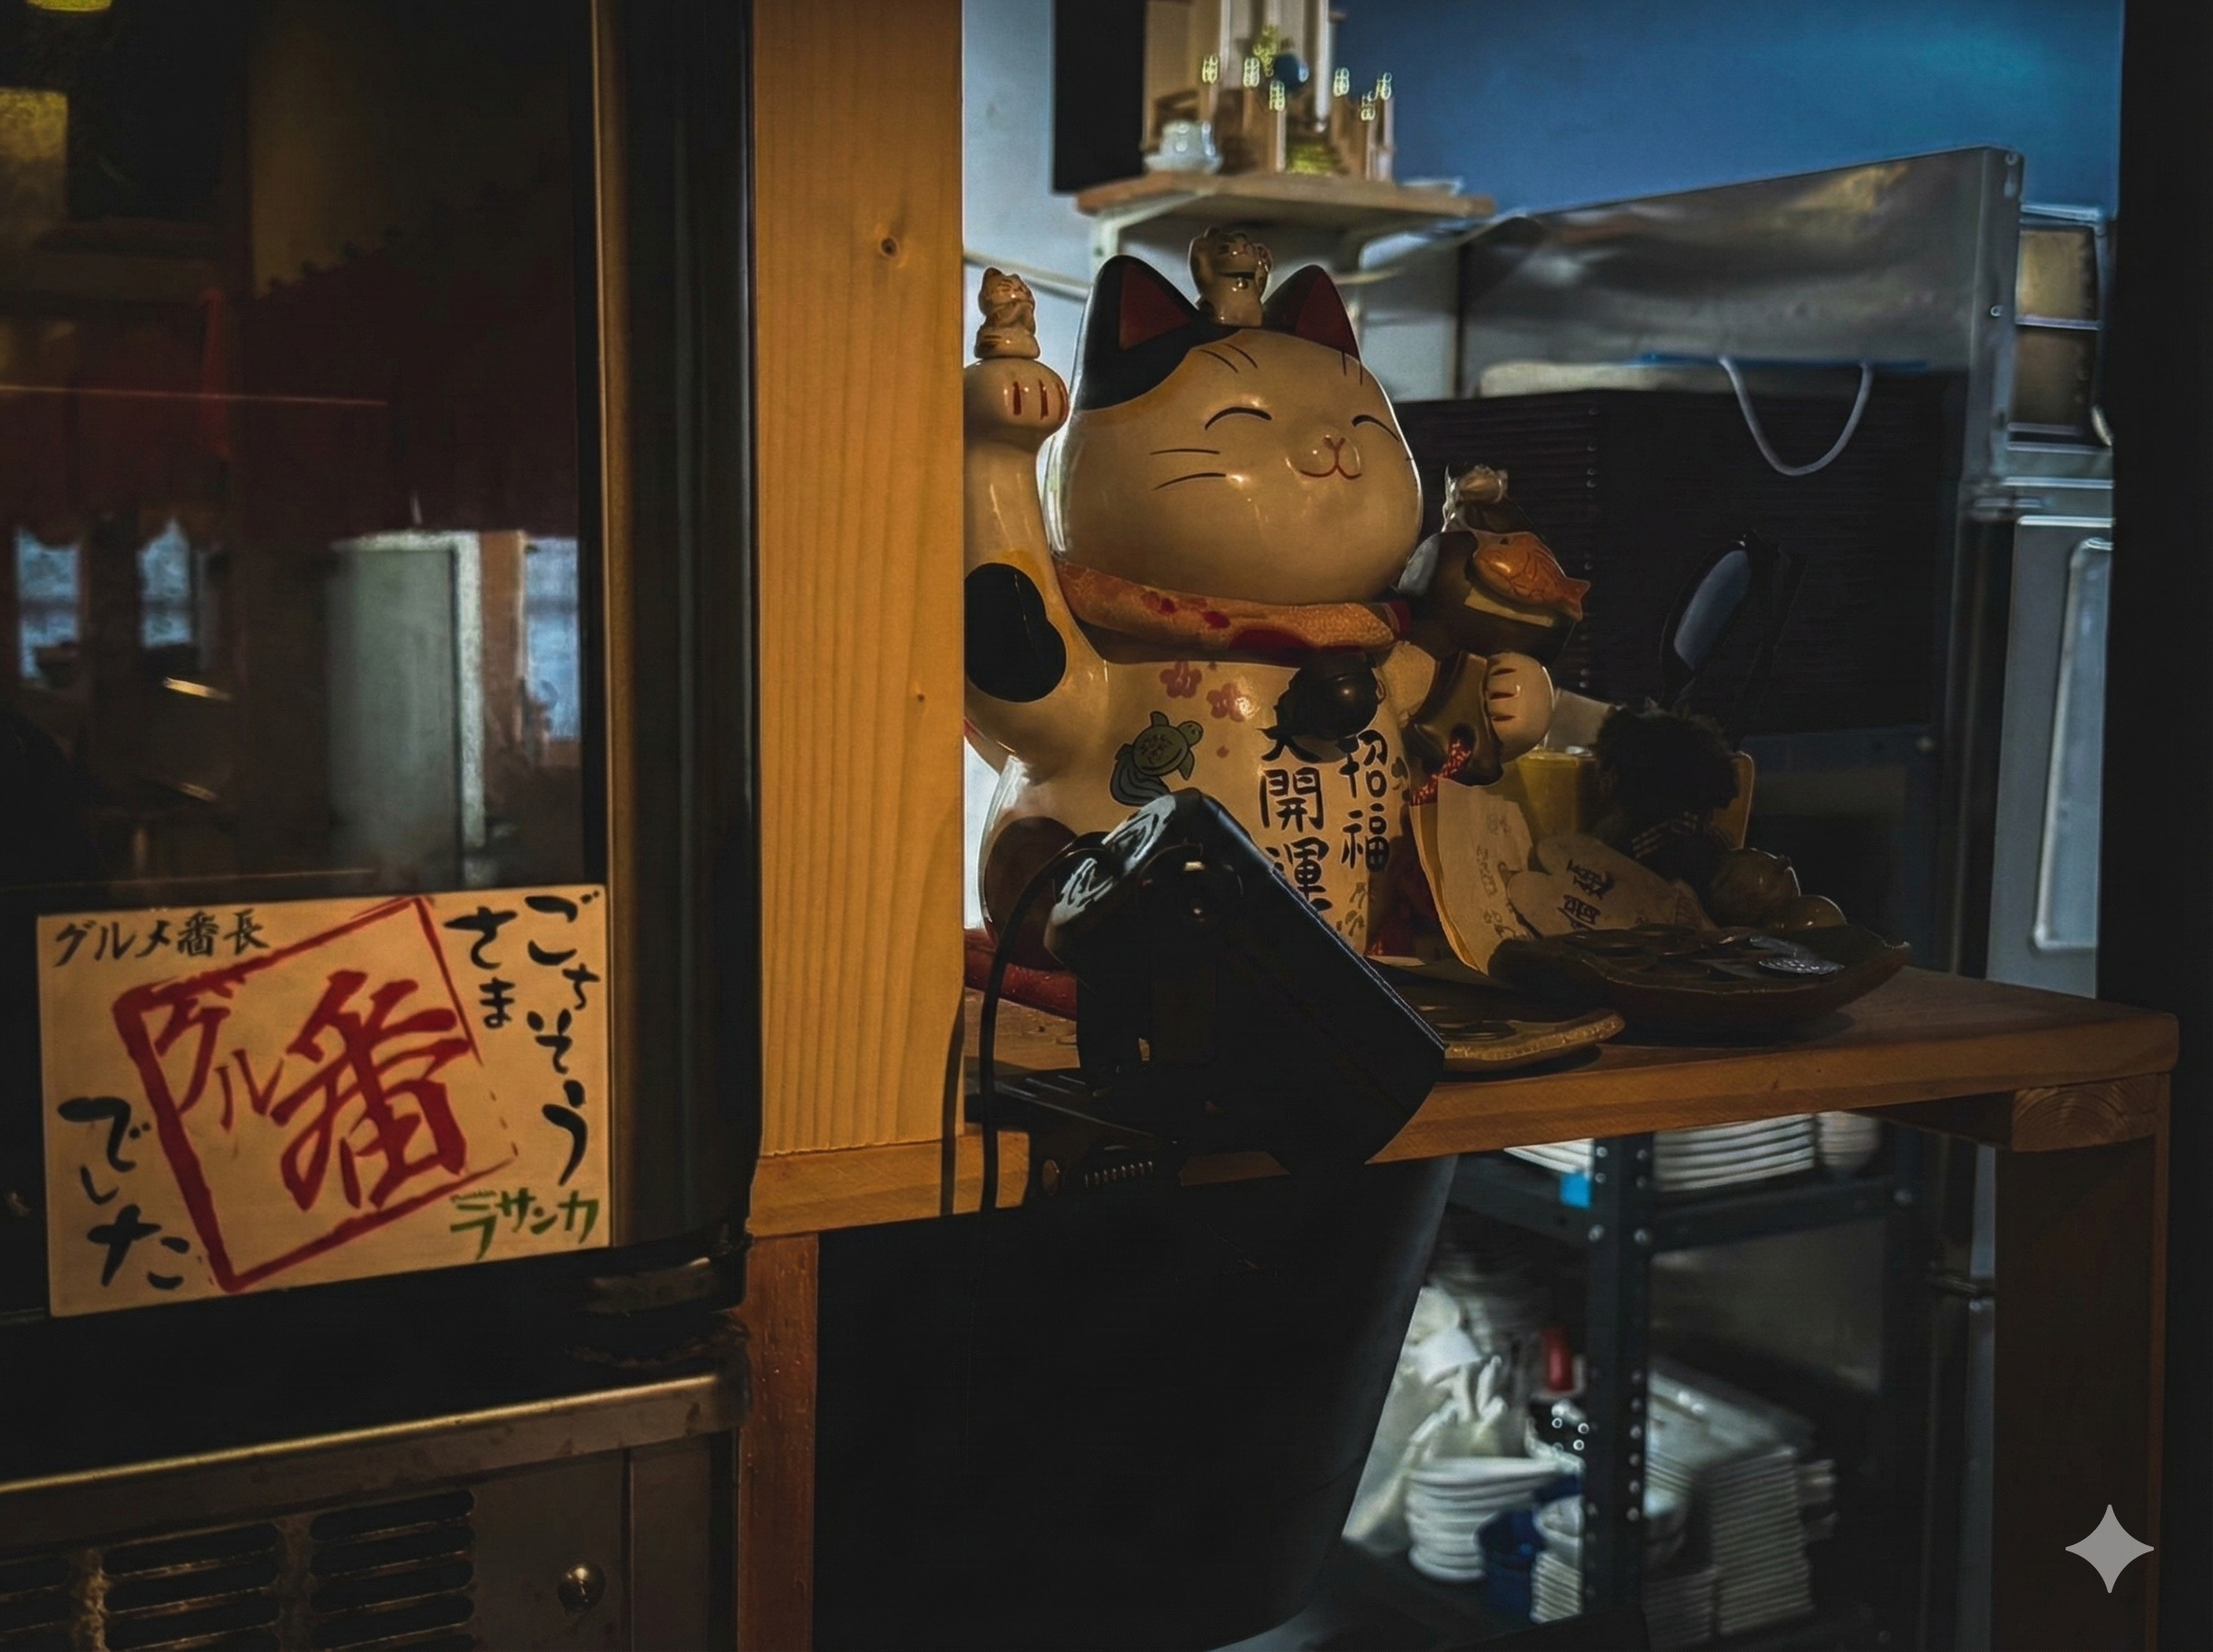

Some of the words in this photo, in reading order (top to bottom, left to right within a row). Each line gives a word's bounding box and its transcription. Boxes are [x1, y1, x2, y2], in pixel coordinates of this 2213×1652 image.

[53, 907, 271, 967] グルメ番長
[443, 906, 518, 1029] さま
[524, 890, 601, 1186] ごちそう
[57, 1097, 191, 1291] でした
